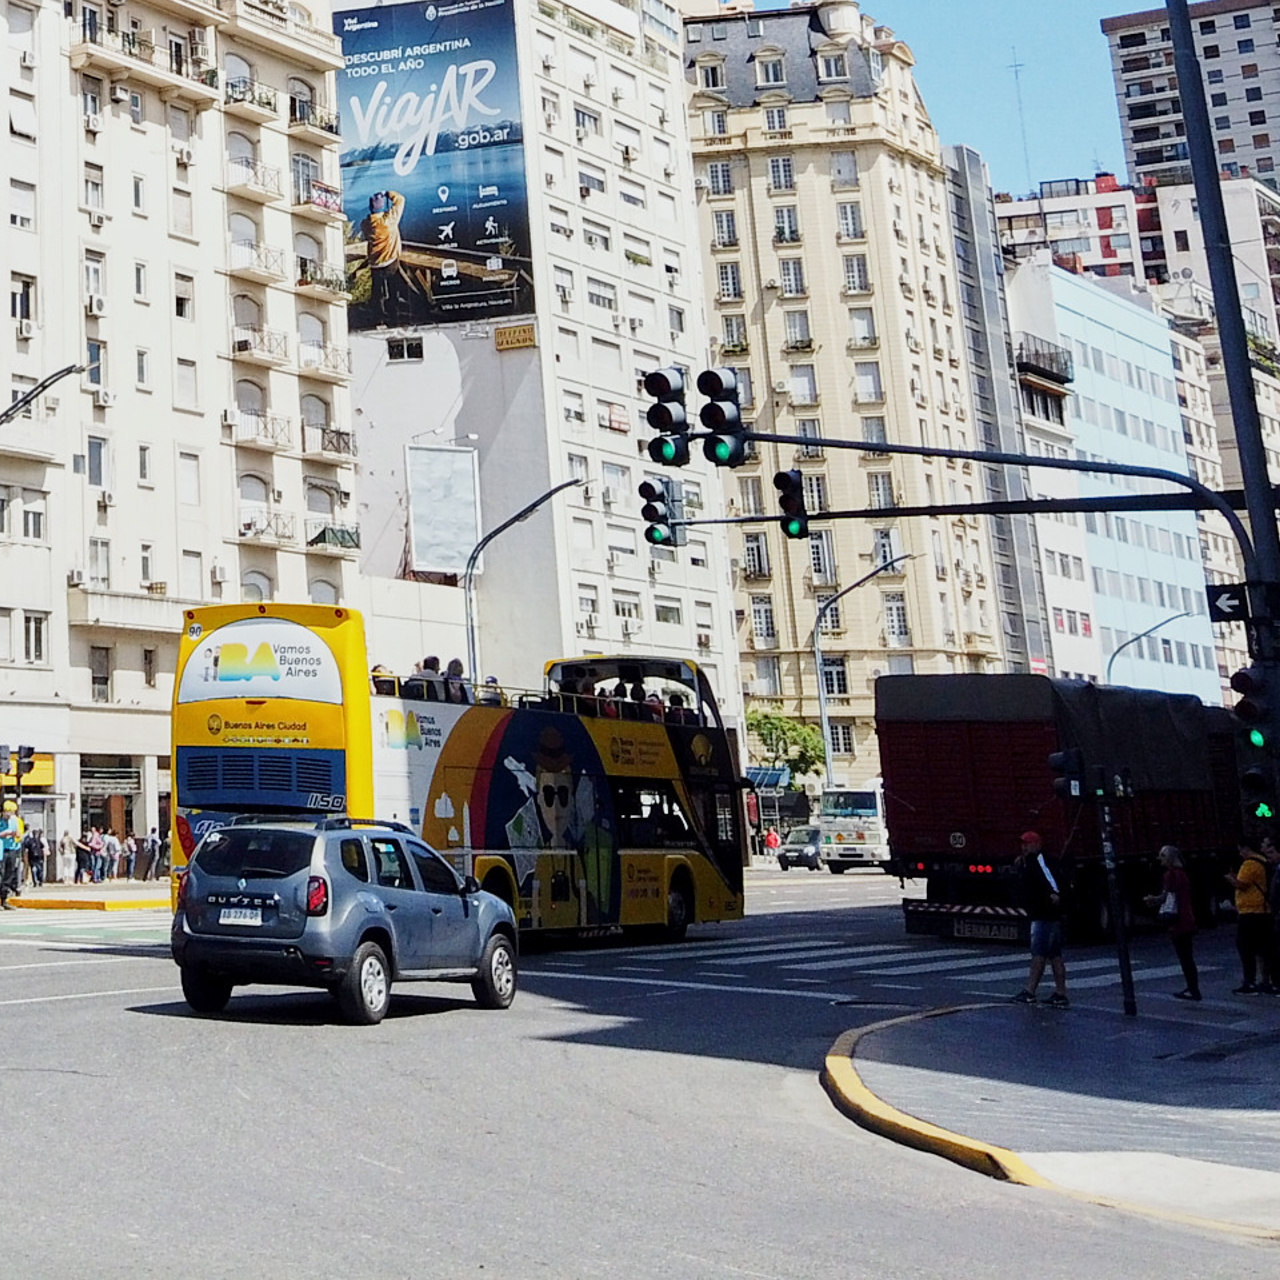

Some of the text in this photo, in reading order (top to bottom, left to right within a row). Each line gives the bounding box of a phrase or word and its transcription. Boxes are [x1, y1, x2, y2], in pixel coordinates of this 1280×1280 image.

[345, 37, 471, 65] DESCUBRÍ ARGENTINA
[345, 58, 425, 78] TODO EL AÑO
[454, 127, 510, 150] .gob.ar
[188, 625, 203, 637] 90
[273, 643, 311, 655] Vamos
[279, 655, 322, 666] Buenos
[285, 667, 318, 677] Aires
[224, 721, 308, 731] Buenos Aires Ciudad
